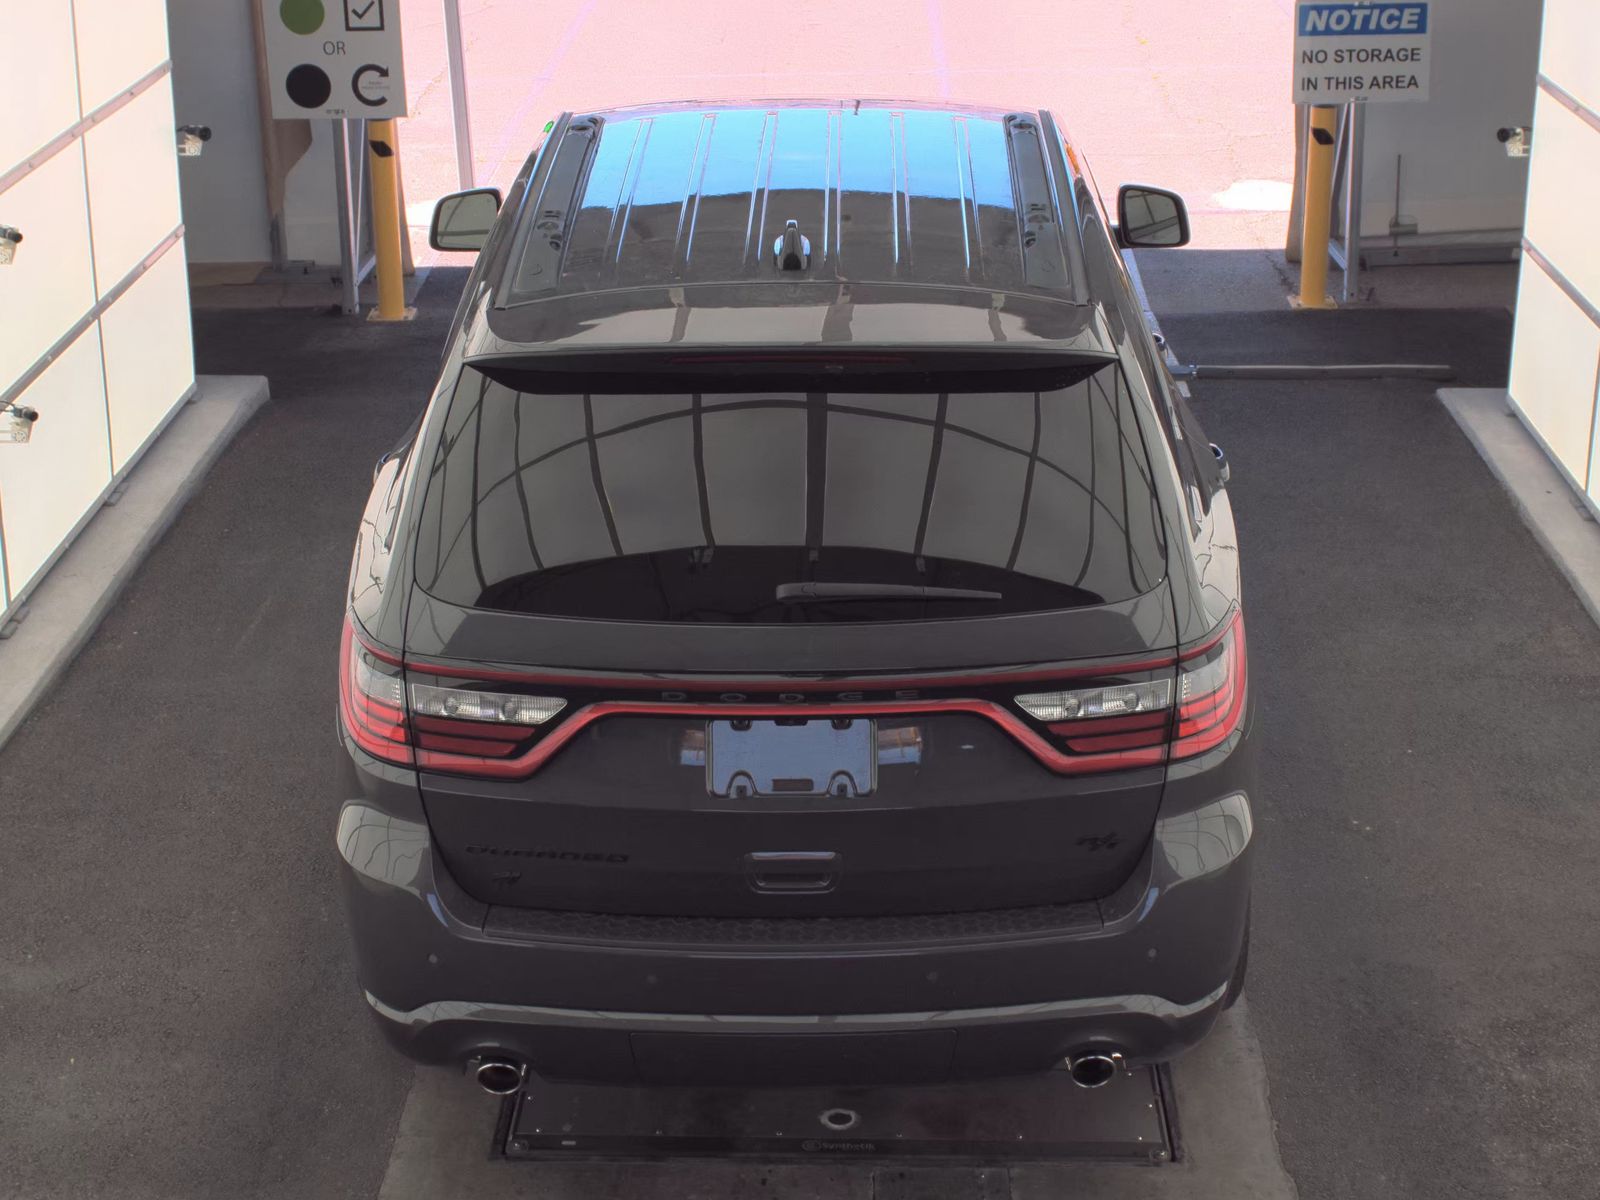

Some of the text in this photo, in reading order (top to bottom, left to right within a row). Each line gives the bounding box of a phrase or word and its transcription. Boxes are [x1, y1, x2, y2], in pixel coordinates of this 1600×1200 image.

[1305, 8, 1421, 31] NOTICE
[323, 41, 346, 55] OR
[1302, 48, 1421, 64] NO STORAGE
[1302, 75, 1419, 91] IN THIS AREA
[660, 689, 921, 702] DODGE
